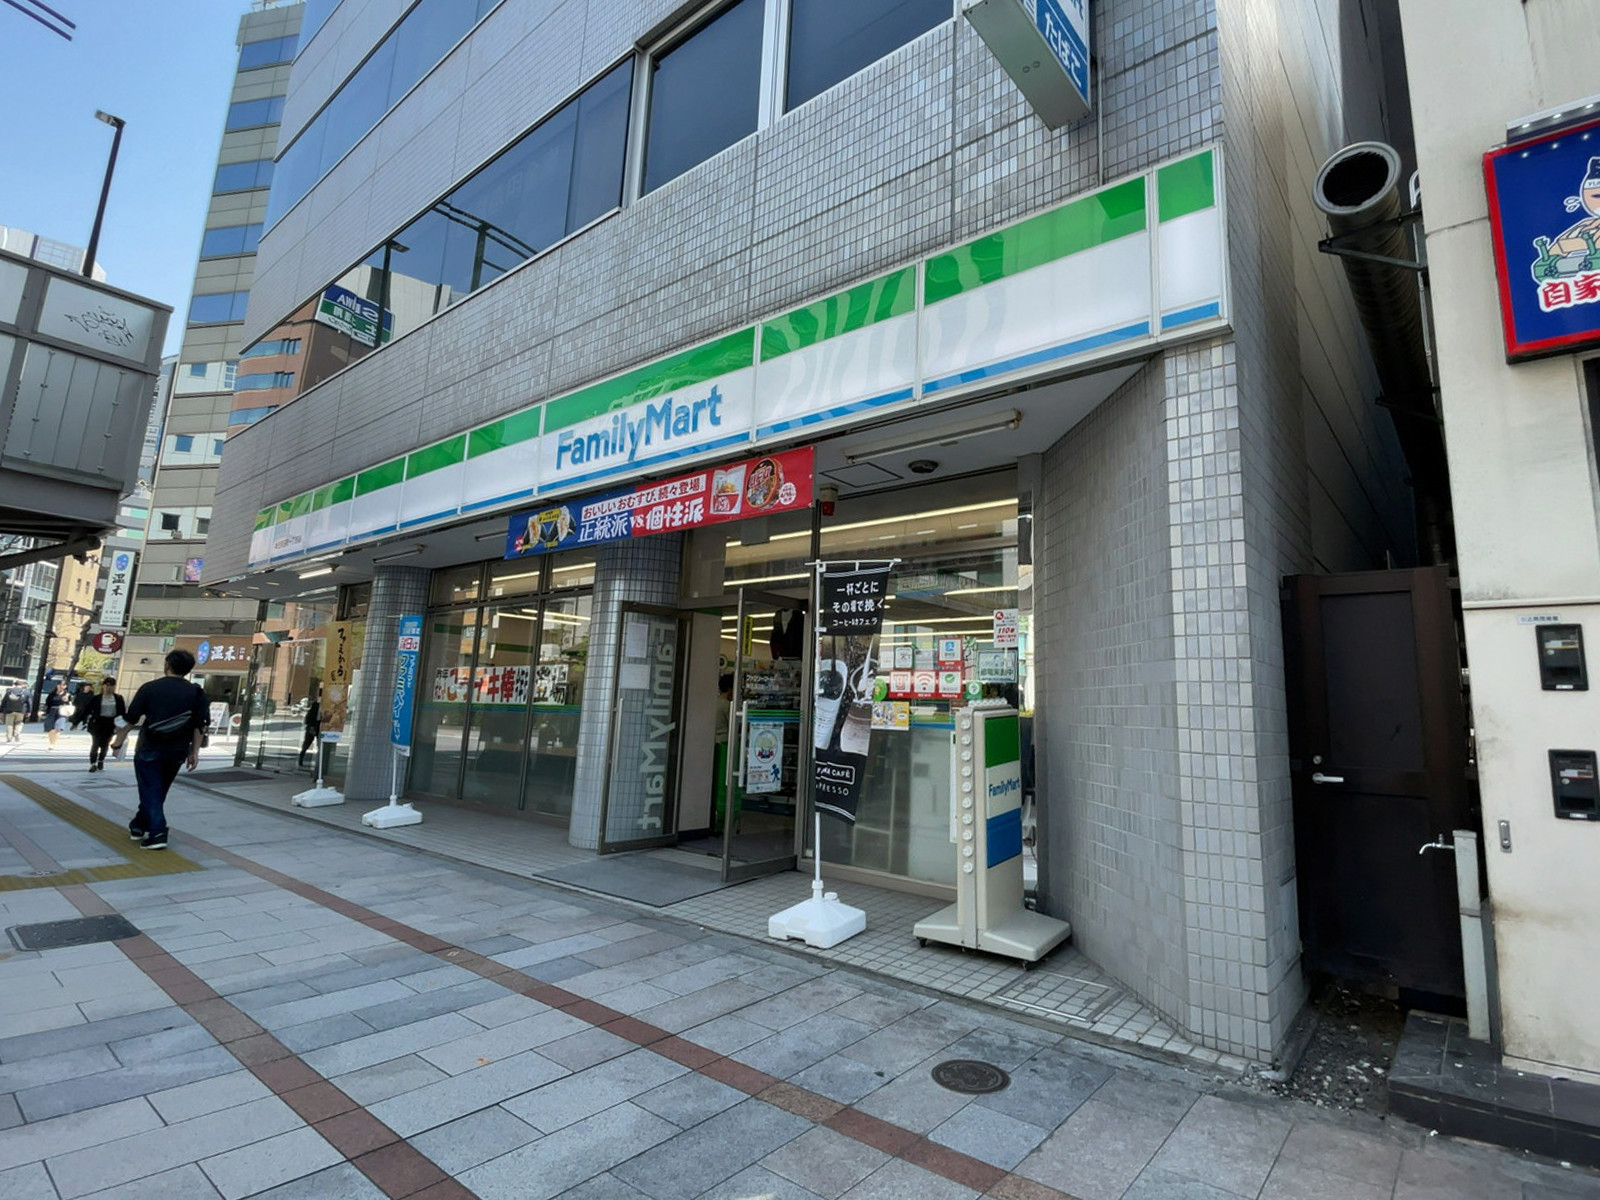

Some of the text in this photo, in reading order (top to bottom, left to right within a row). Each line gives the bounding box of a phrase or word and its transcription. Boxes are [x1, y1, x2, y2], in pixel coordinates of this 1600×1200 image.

[1045, 12, 1082, 89] たばこ
[556, 384, 722, 470] FamilyMart
[578, 512, 628, 542] 正統派
[645, 497, 704, 531] 個性派
[836, 581, 879, 596] 一杯ごとに
[988, 777, 1020, 798] FamilyMart
